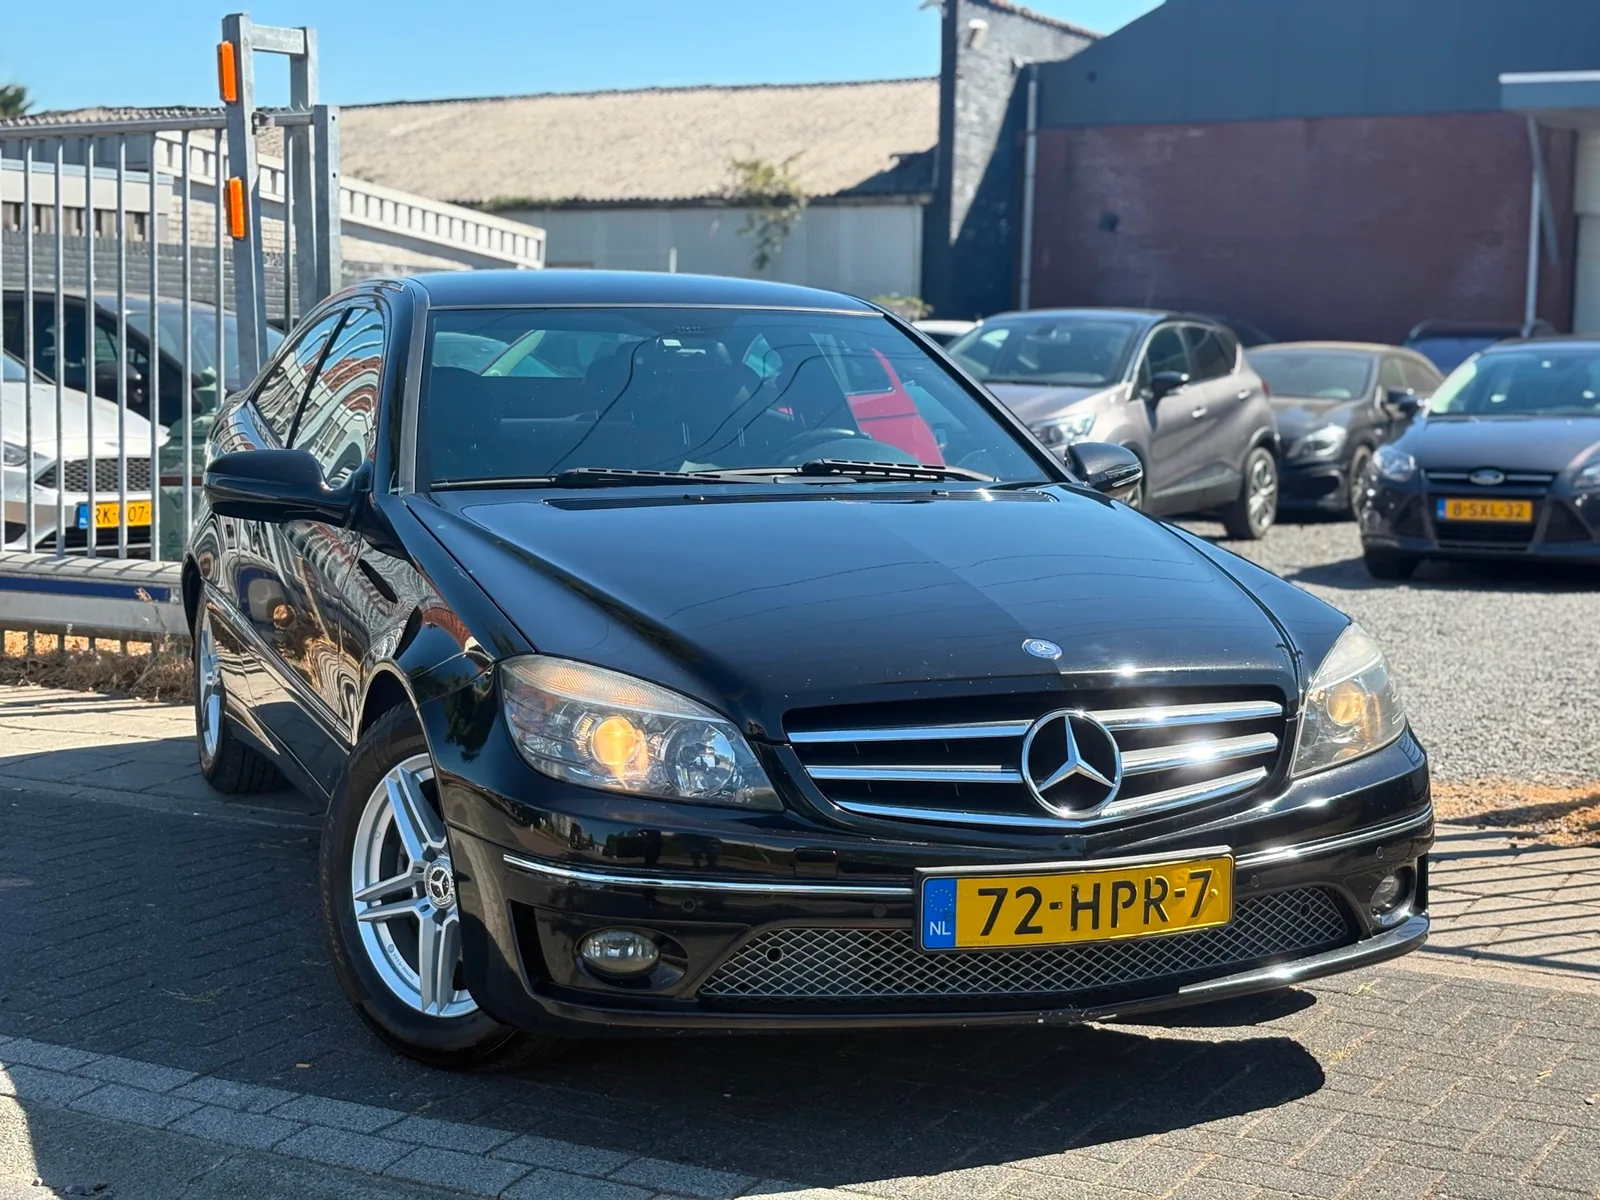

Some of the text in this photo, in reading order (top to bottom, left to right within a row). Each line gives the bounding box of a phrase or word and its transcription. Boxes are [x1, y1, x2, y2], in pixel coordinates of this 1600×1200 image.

[95, 506, 151, 524] RK-07-
[977, 867, 1213, 937] 72-HPR-7
[929, 920, 951, 936] NL
